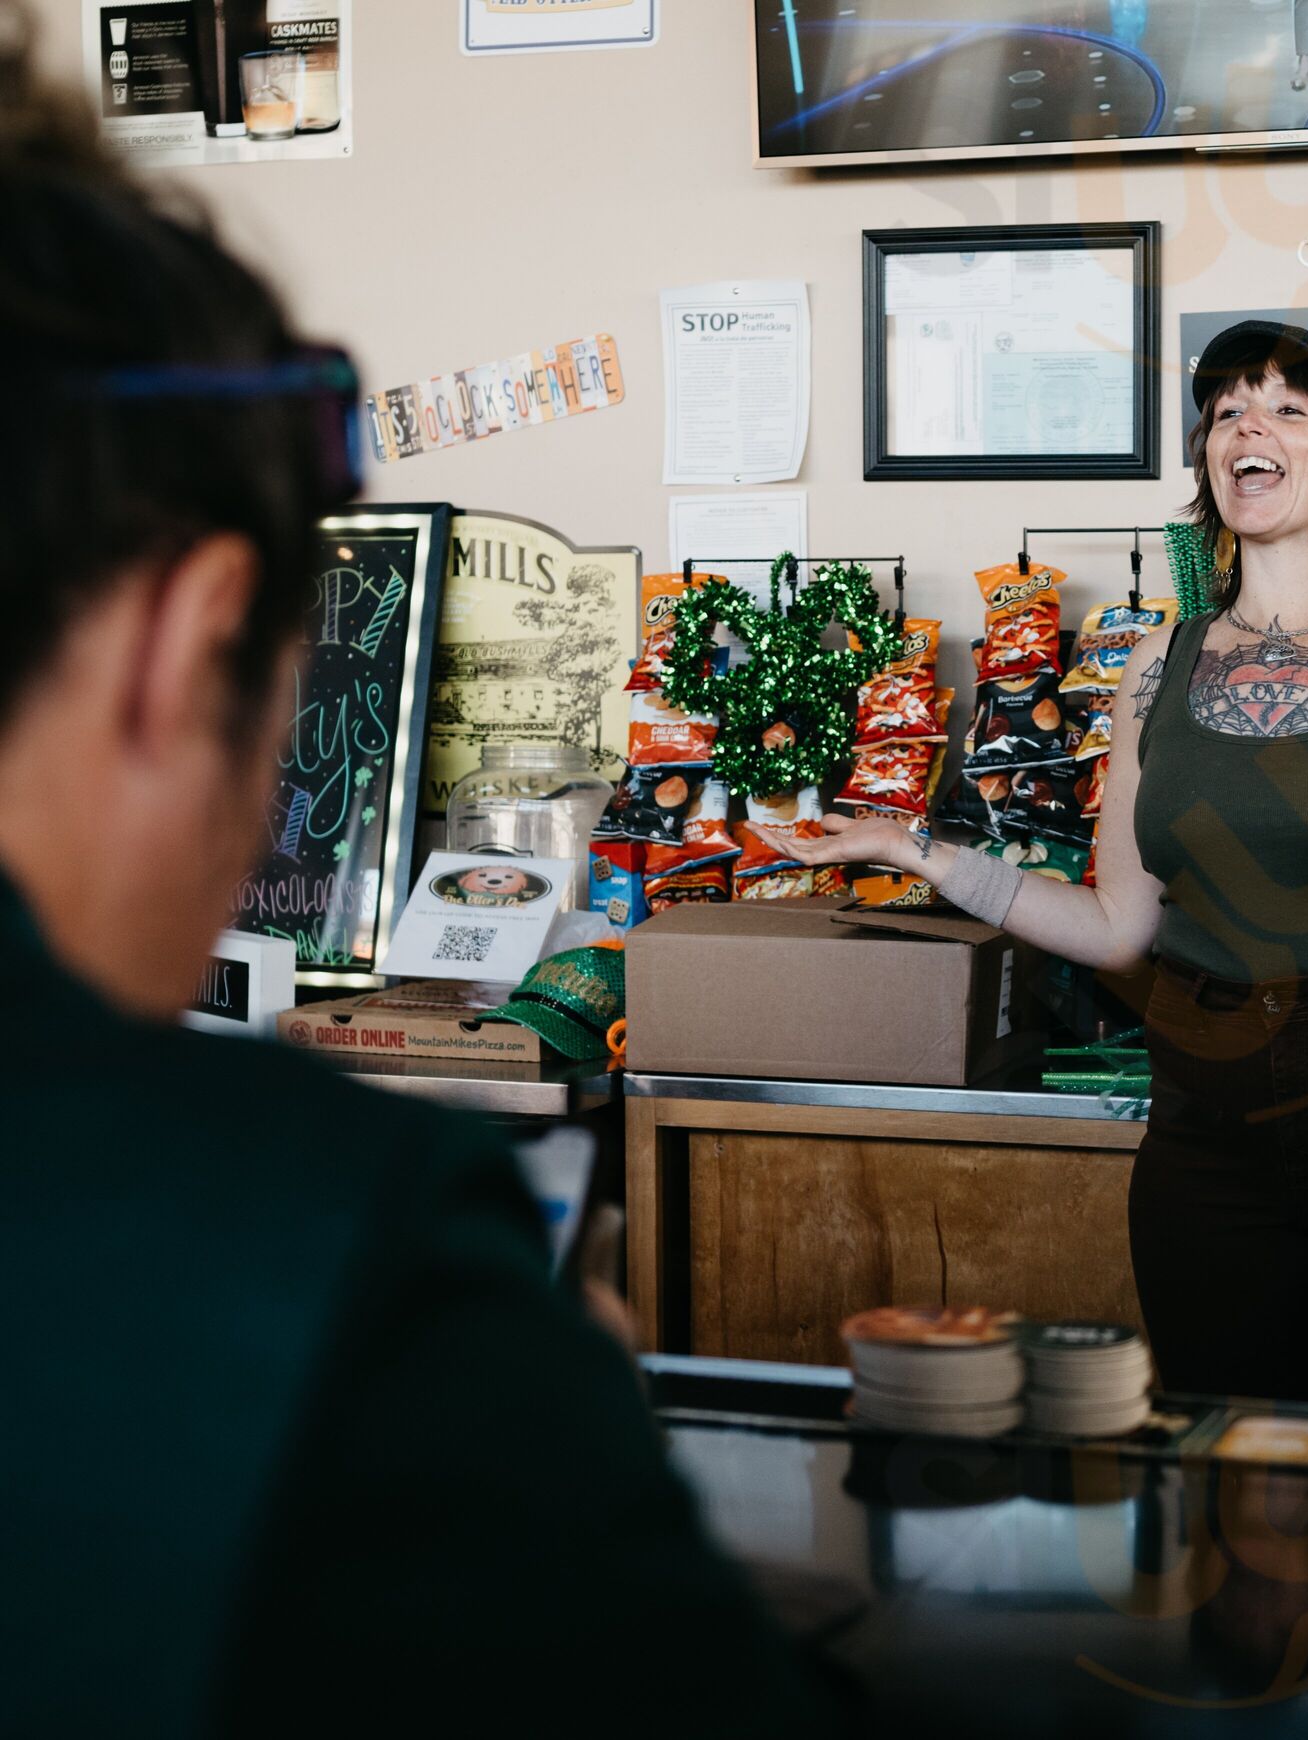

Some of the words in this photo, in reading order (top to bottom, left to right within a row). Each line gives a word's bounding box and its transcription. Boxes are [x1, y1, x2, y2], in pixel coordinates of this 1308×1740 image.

[270, 21, 338, 38] CASKMATES
[682, 313, 739, 332] STOP
[742, 312, 775, 320] Human
[742, 323, 791, 333] Trafficking
[452, 536, 556, 595] MILLS
[990, 571, 1052, 610] Cheetos
[997, 693, 1033, 704] Barbecue
[1229, 683, 1306, 702] LOVE
[651, 725, 690, 736] CHEDDAR
[316, 1026, 358, 1046] ORDER
[360, 1029, 405, 1049] ONLINE
[407, 1035, 526, 1052] MountainMikesPizza.com
